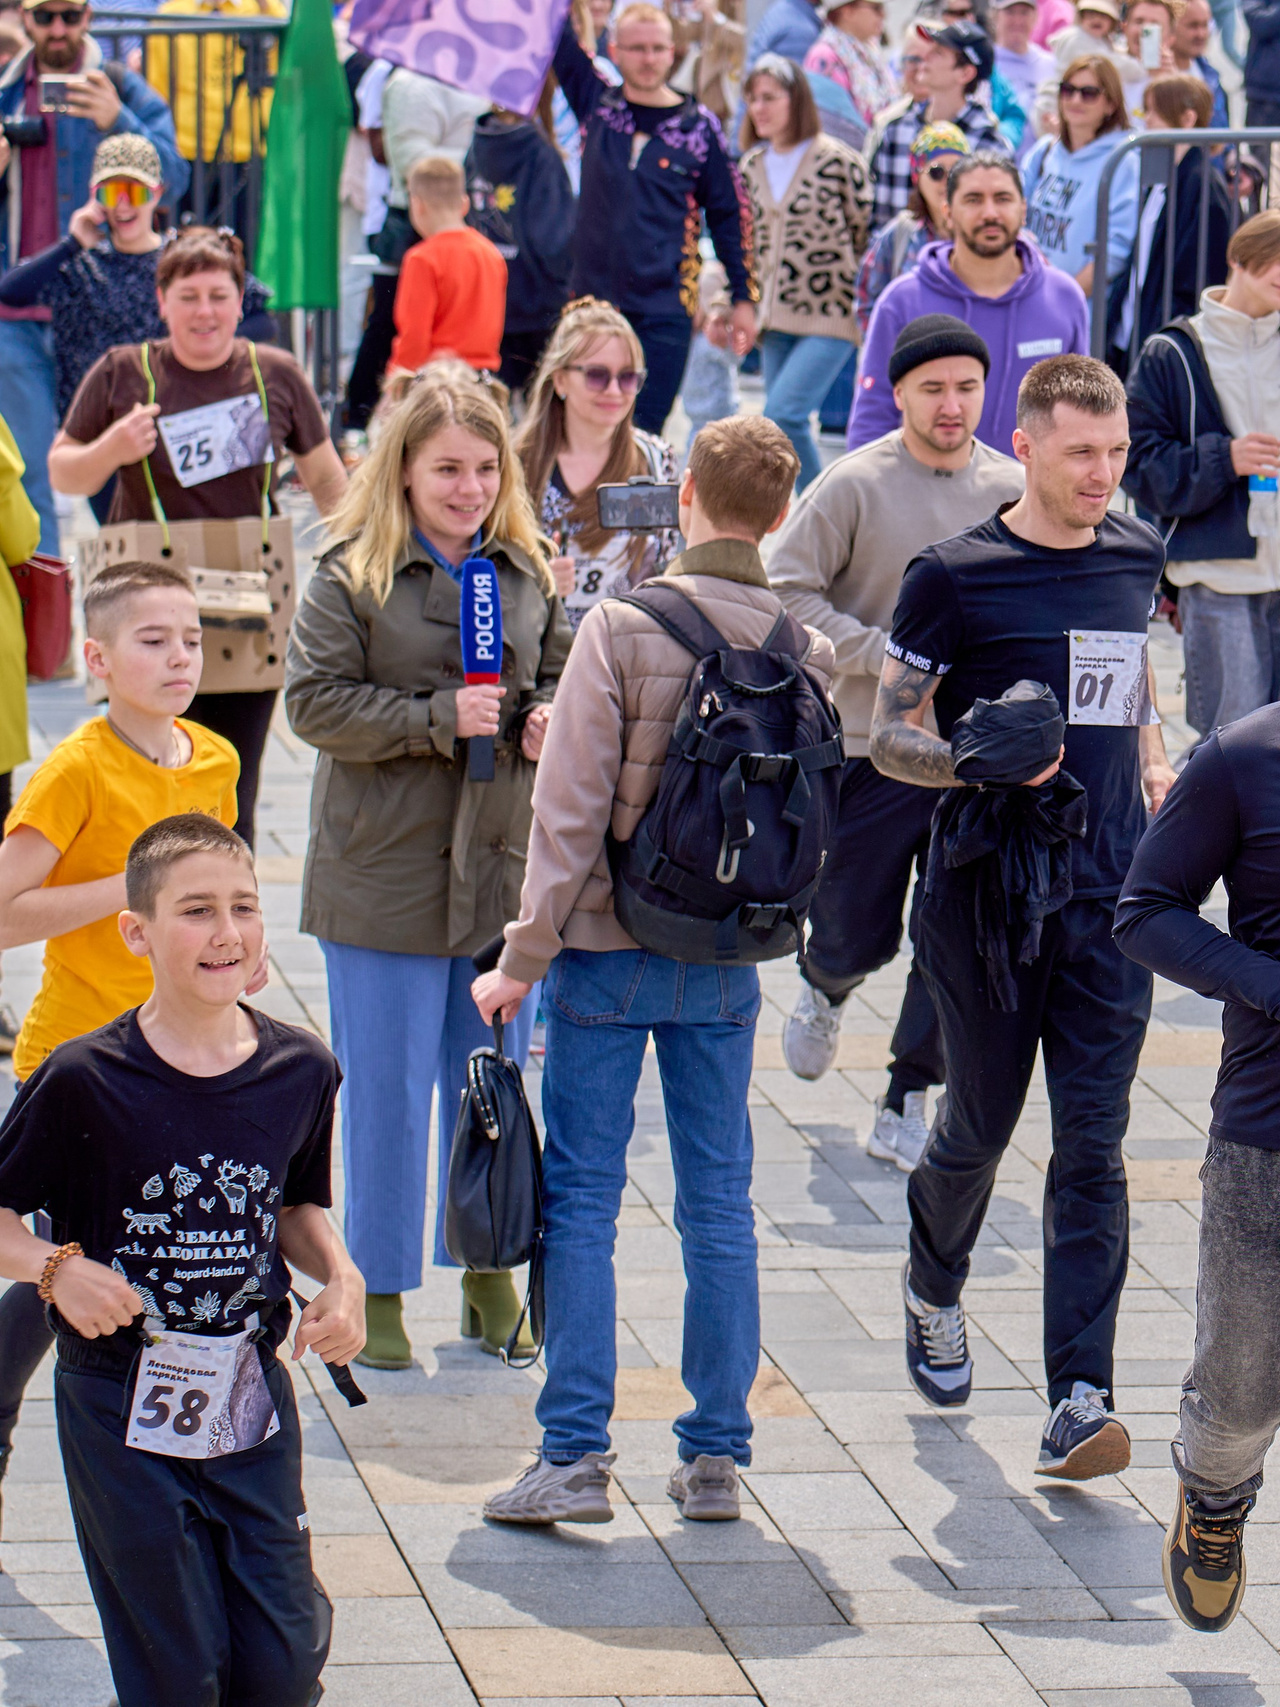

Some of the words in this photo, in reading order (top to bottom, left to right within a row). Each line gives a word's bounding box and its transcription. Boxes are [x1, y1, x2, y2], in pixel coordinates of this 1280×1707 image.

[178, 438, 212, 472] 25
[473, 573, 494, 660] РОССИЯ
[904, 651, 932, 671] PARIS
[1075, 672, 1114, 710] 01
[172, 1265, 246, 1282] leopard-land.ru
[146, 1369, 190, 1383] зарядка
[147, 1359, 218, 1377] Леопардовая
[136, 1385, 210, 1436] 58
